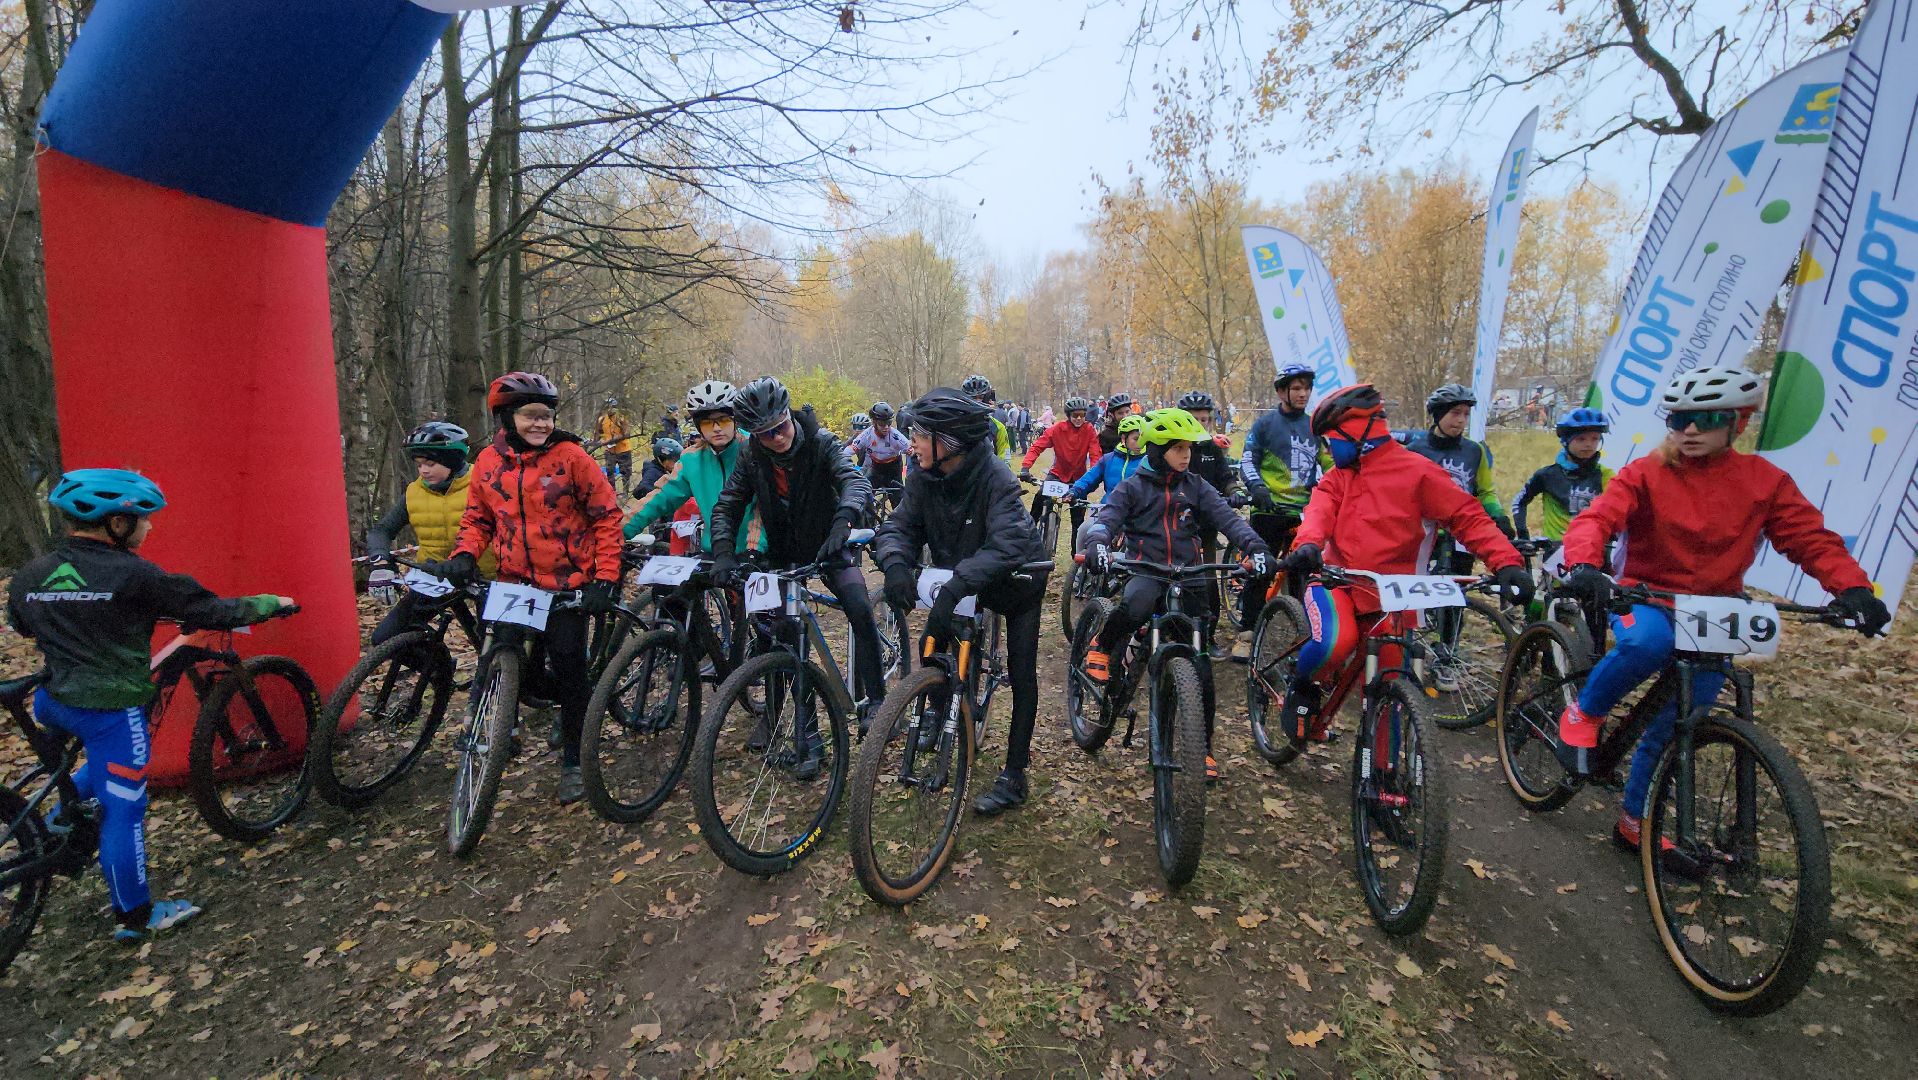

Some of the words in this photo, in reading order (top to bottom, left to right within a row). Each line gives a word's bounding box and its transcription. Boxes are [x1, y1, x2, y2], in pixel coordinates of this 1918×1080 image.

[1689, 309, 1720, 350] ОКРУГ
[1708, 254, 1747, 312] СТУПИНО
[1832, 191, 1918, 388] СПОРТ
[1611, 275, 1695, 406] СПОРТ
[1049, 484, 1063, 494] 55
[653, 563, 684, 576] 73
[25, 591, 113, 602] MERIDA
[1384, 581, 1457, 599] 149
[503, 592, 537, 617] 71
[1687, 610, 1777, 643] 119
